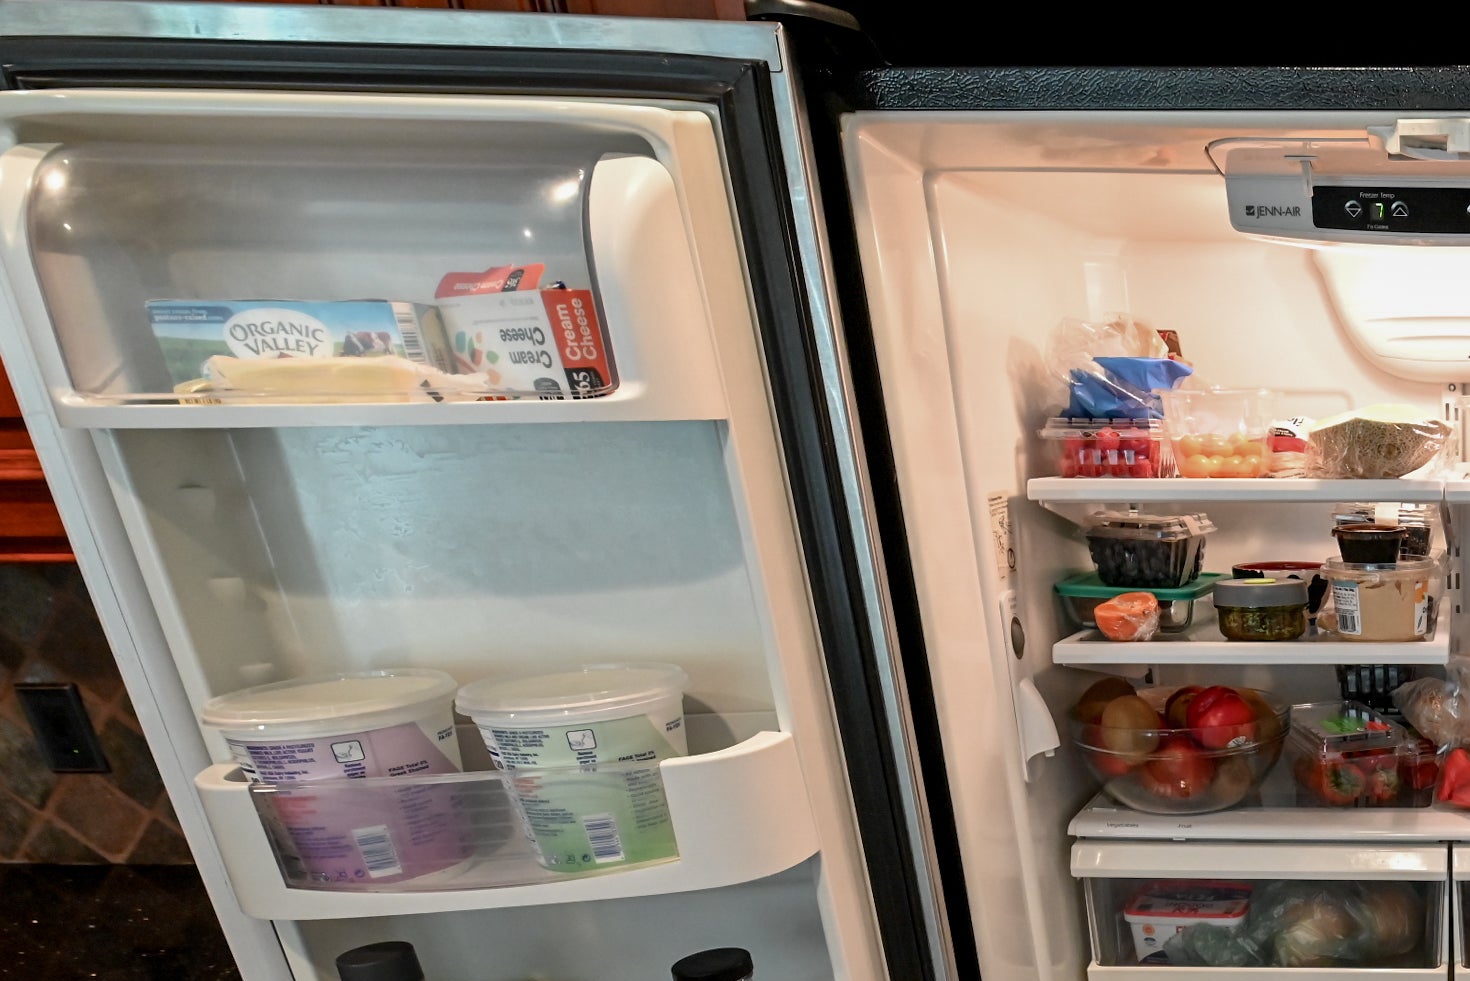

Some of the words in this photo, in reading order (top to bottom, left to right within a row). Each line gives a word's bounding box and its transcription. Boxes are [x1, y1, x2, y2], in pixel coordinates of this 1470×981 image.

[1380, 192, 1395, 200] Temp
[1256, 205, 1301, 219] JENN-AIR
[1375, 203, 1385, 218] 7
[229, 320, 325, 343] ORGANIC
[499, 326, 546, 346] Cheese
[556, 304, 581, 361] Cream
[571, 298, 597, 360] Cheese
[244, 338, 319, 356] VALLEY
[509, 350, 552, 369] Cream
